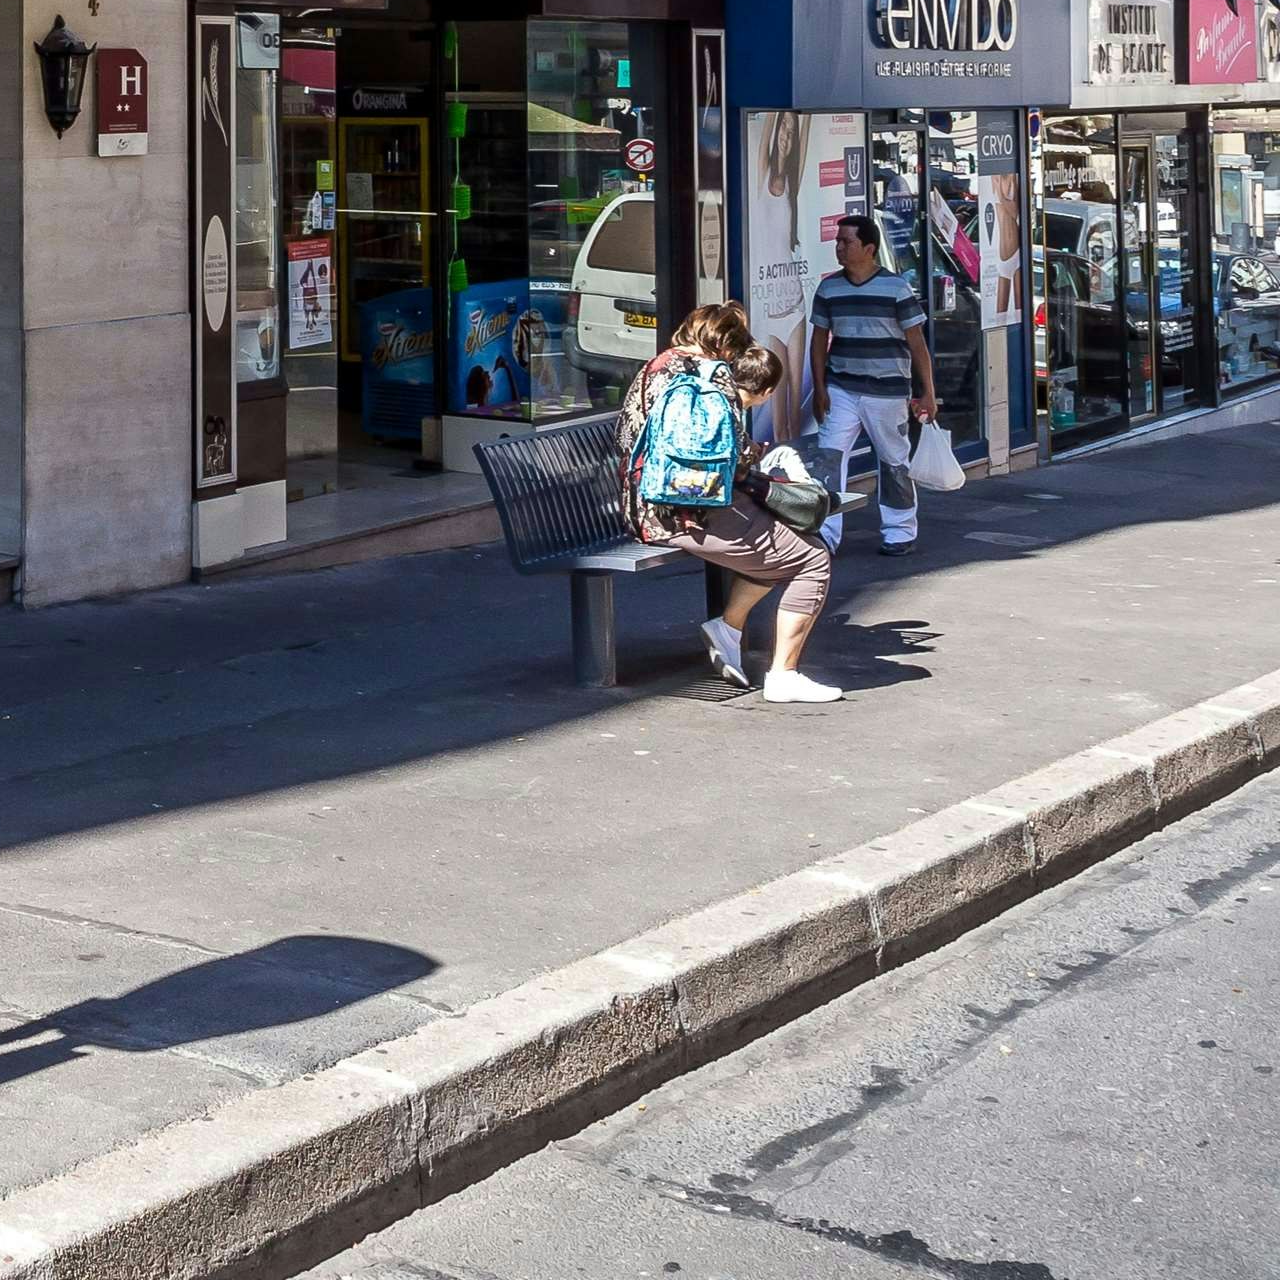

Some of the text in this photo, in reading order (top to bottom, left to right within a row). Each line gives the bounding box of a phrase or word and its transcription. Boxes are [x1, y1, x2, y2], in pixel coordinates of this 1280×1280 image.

[1108, 3, 1157, 35] INSTITUT
[1098, 42, 1167, 74] DE BEAUTE
[120, 65, 142, 96] H
[352, 89, 408, 110] ORANGINA
[981, 133, 1013, 157] CRYO
[759, 265, 765, 281] 5
